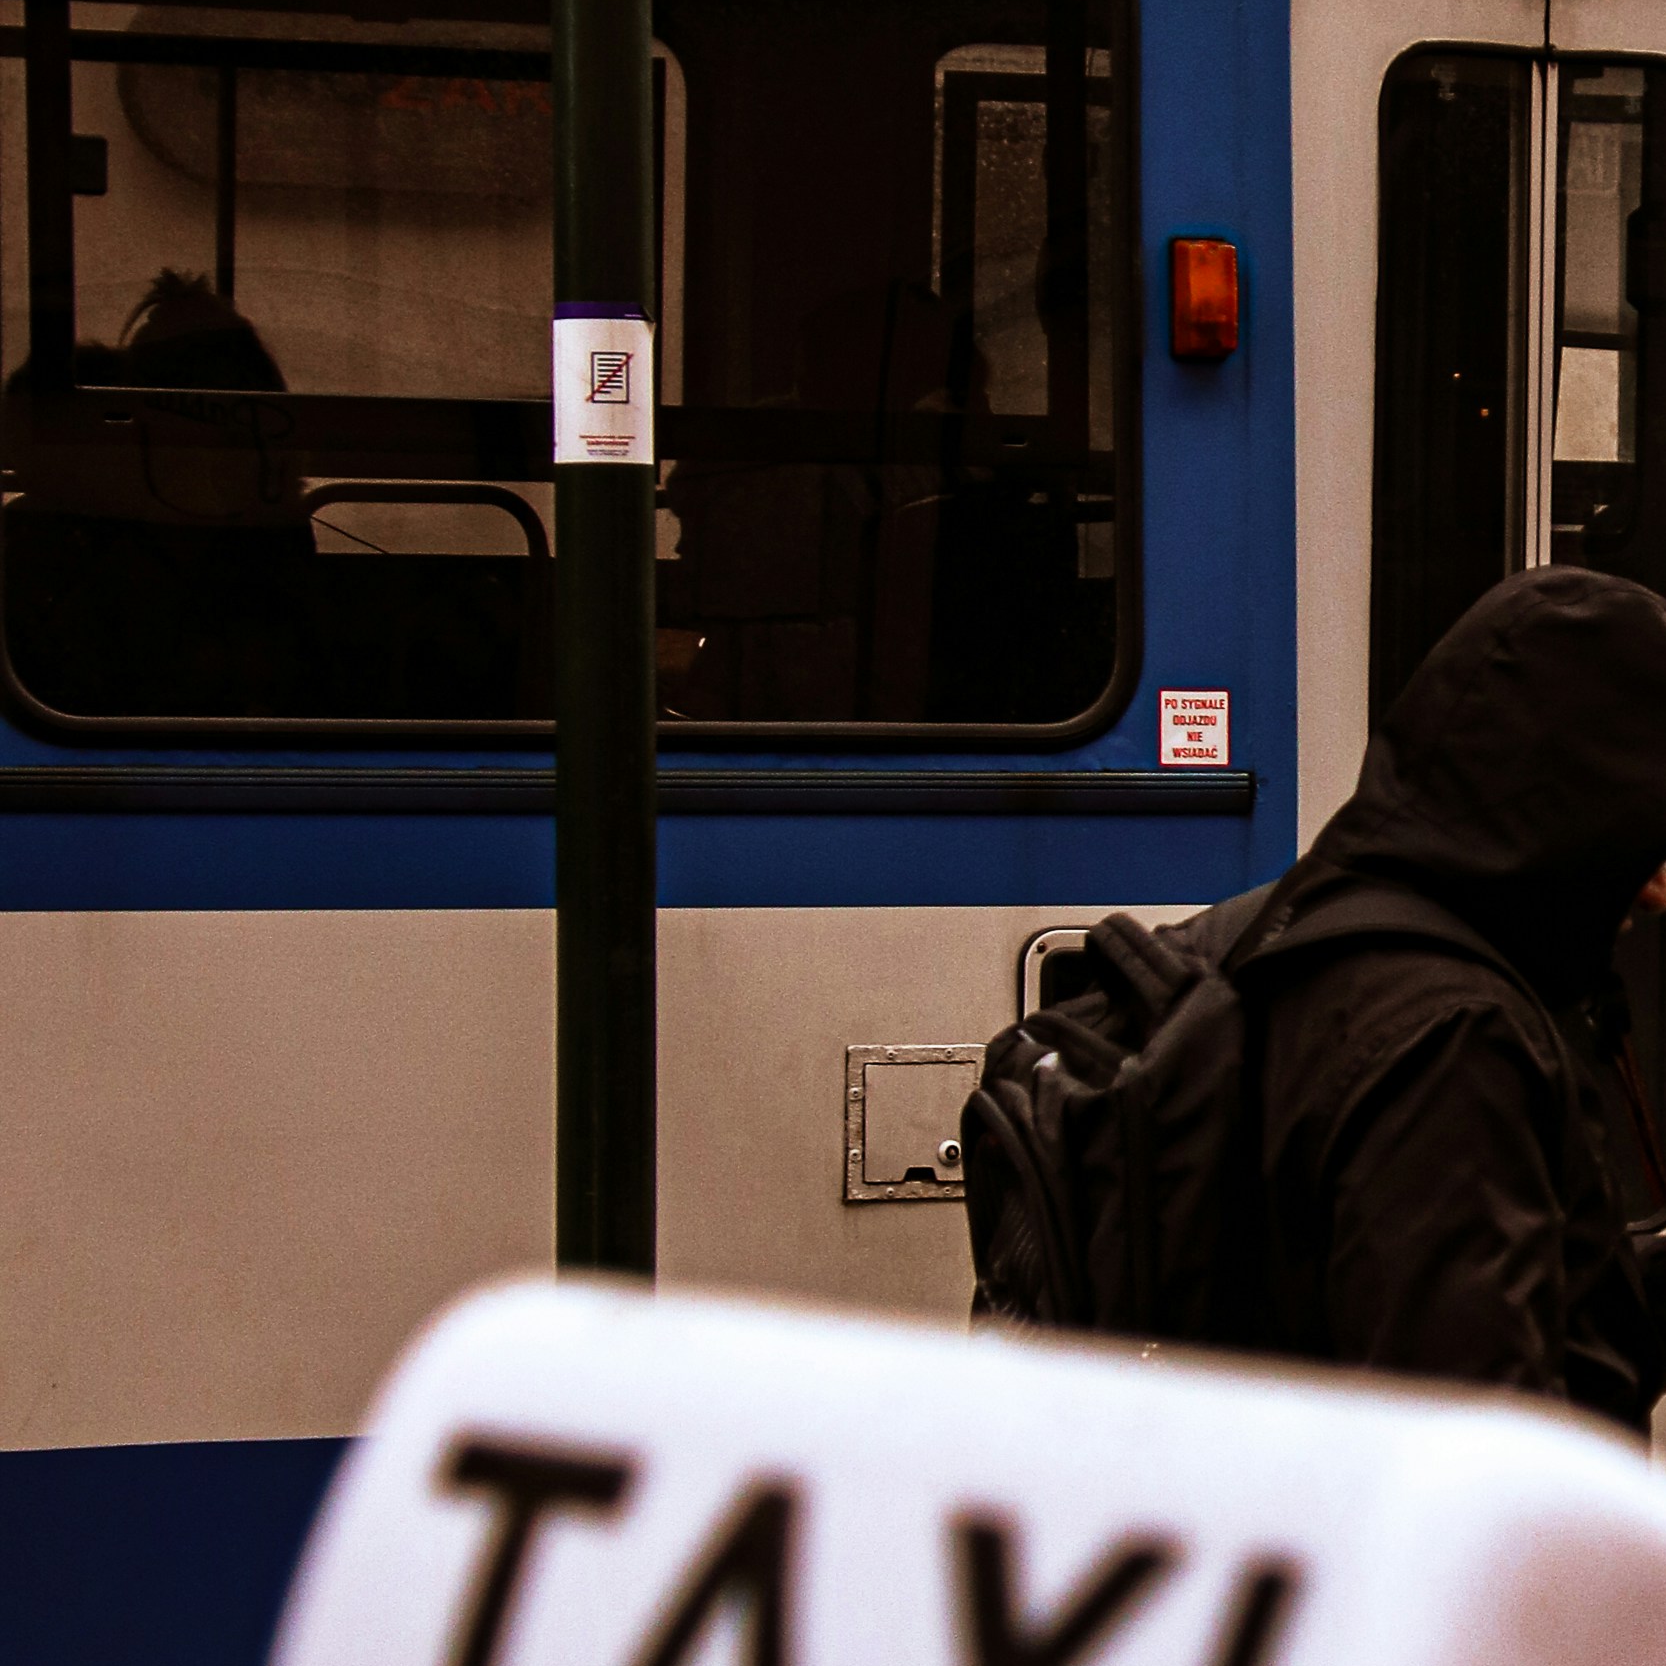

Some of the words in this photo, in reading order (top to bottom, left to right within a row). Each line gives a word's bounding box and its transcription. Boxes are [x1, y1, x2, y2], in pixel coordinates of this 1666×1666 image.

[1164, 699, 1178, 709] PO
[1181, 699, 1225, 709] SYGNALE
[1173, 715, 1217, 726] ODJAZDU
[1187, 731, 1203, 742] NIE
[1172, 745, 1218, 758] WSIADAĆ
